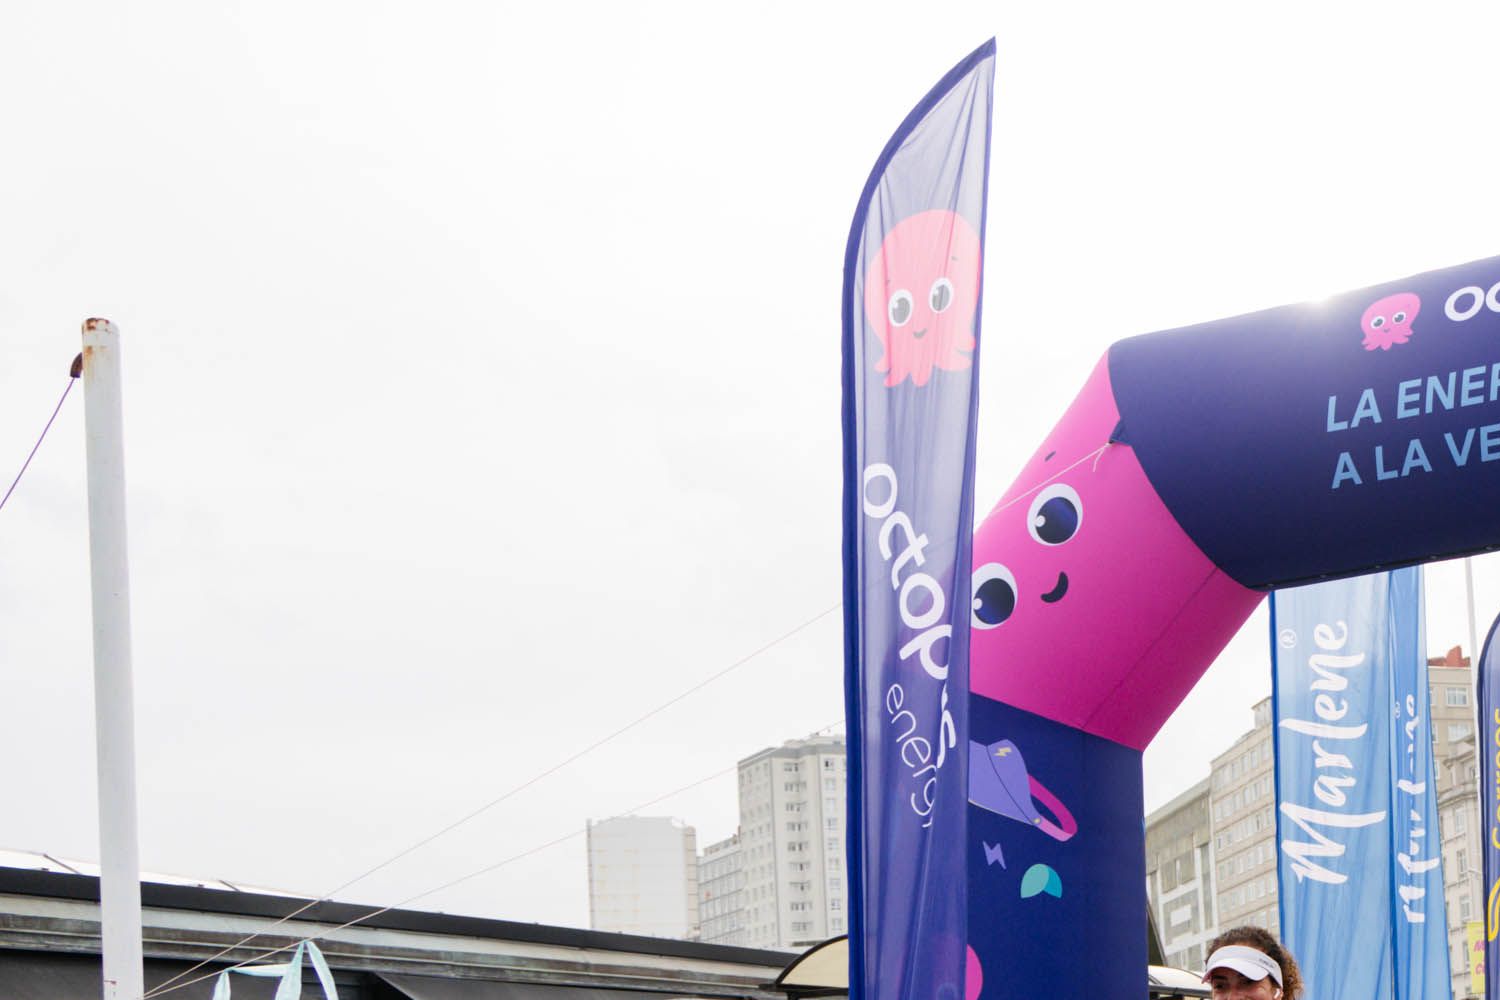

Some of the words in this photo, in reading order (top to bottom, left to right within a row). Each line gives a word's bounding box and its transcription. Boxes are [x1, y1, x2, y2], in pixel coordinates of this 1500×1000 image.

[1325, 388, 1382, 432] LA
[1331, 452, 1362, 489] A
[1374, 439, 1432, 481] LA
[886, 683, 937, 828] energ
[1279, 619, 1387, 885] Marlene
